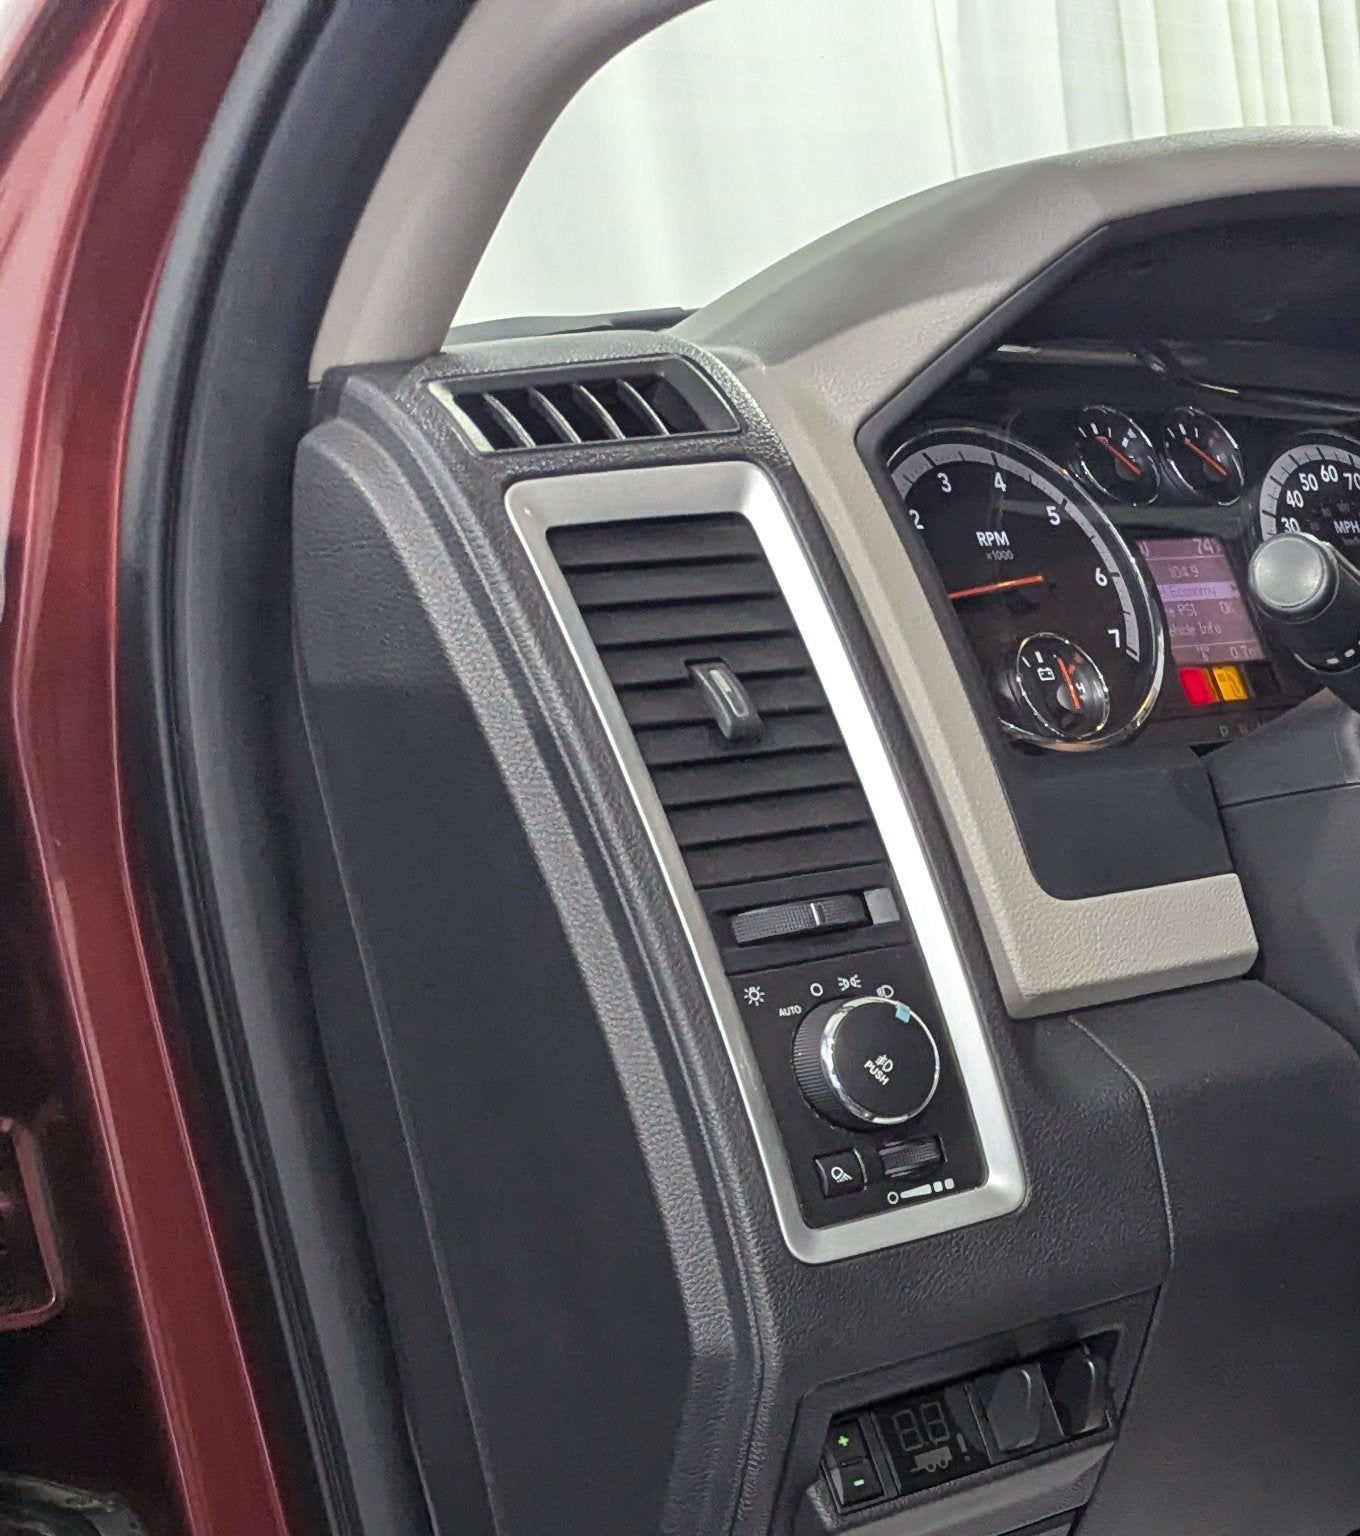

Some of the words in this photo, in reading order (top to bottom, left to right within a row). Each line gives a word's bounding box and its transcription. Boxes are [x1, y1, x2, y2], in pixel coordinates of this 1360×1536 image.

[937, 472, 952, 493] 3
[994, 472, 1007, 492] 4
[1299, 473, 1318, 491] 50
[1320, 464, 1338, 482] 60
[1286, 490, 1304, 508] 40
[909, 509, 925, 529] 2
[1046, 505, 1061, 526] 5
[1281, 517, 1299, 533] 30
[1333, 520, 1360, 534] MPH
[975, 531, 1010, 547] RPM
[1095, 567, 1108, 587] 6
[1108, 628, 1120, 648] 7
[779, 1005, 802, 1017] AUTO
[864, 1060, 890, 1086] PUSH
